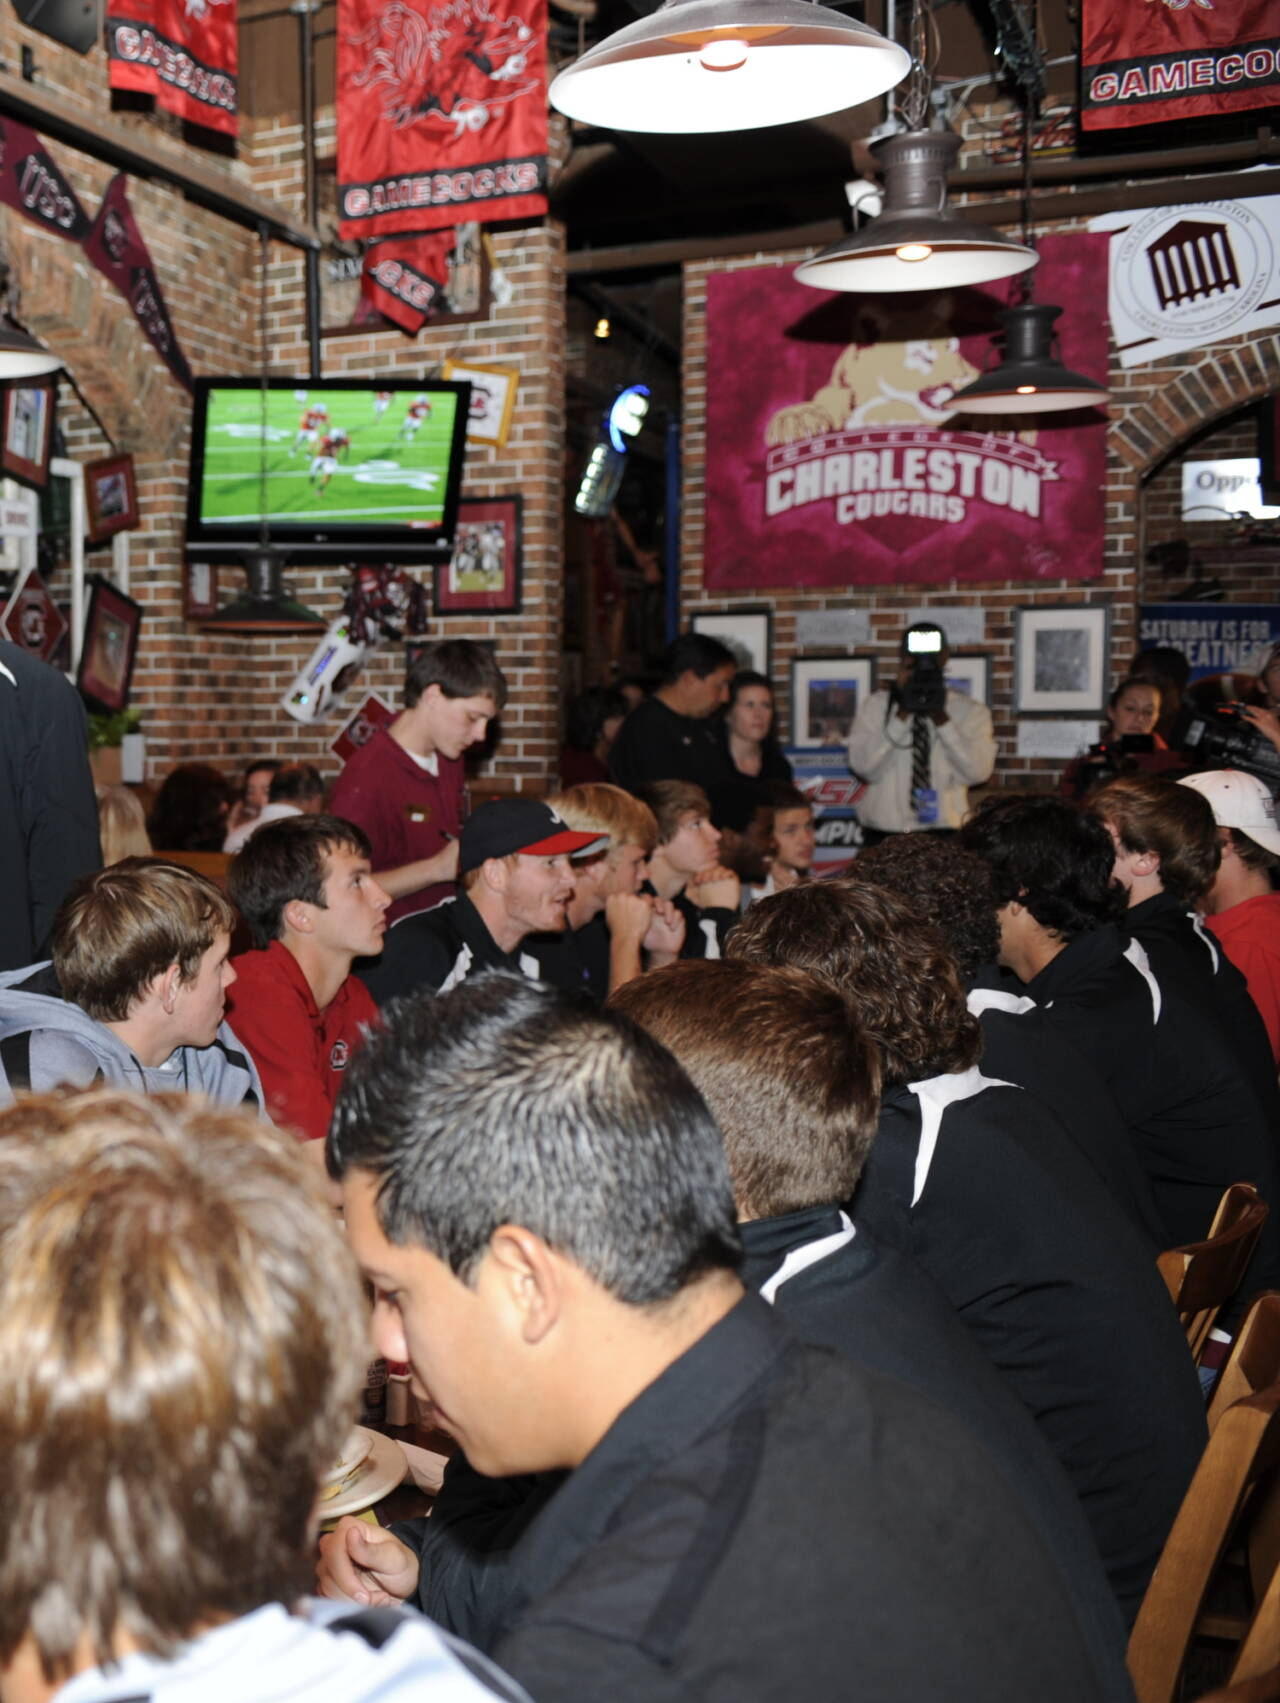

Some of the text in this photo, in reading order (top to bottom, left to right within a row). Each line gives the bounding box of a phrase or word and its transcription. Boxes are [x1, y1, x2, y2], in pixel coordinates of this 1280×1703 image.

[1089, 49, 1280, 101] GAMECO
[344, 162, 539, 217] GAMECOCKS
[766, 448, 1041, 518] CHARLESTON
[836, 491, 967, 525] COUGARS
[1140, 619, 1271, 641] SATURDAY IS FOR
